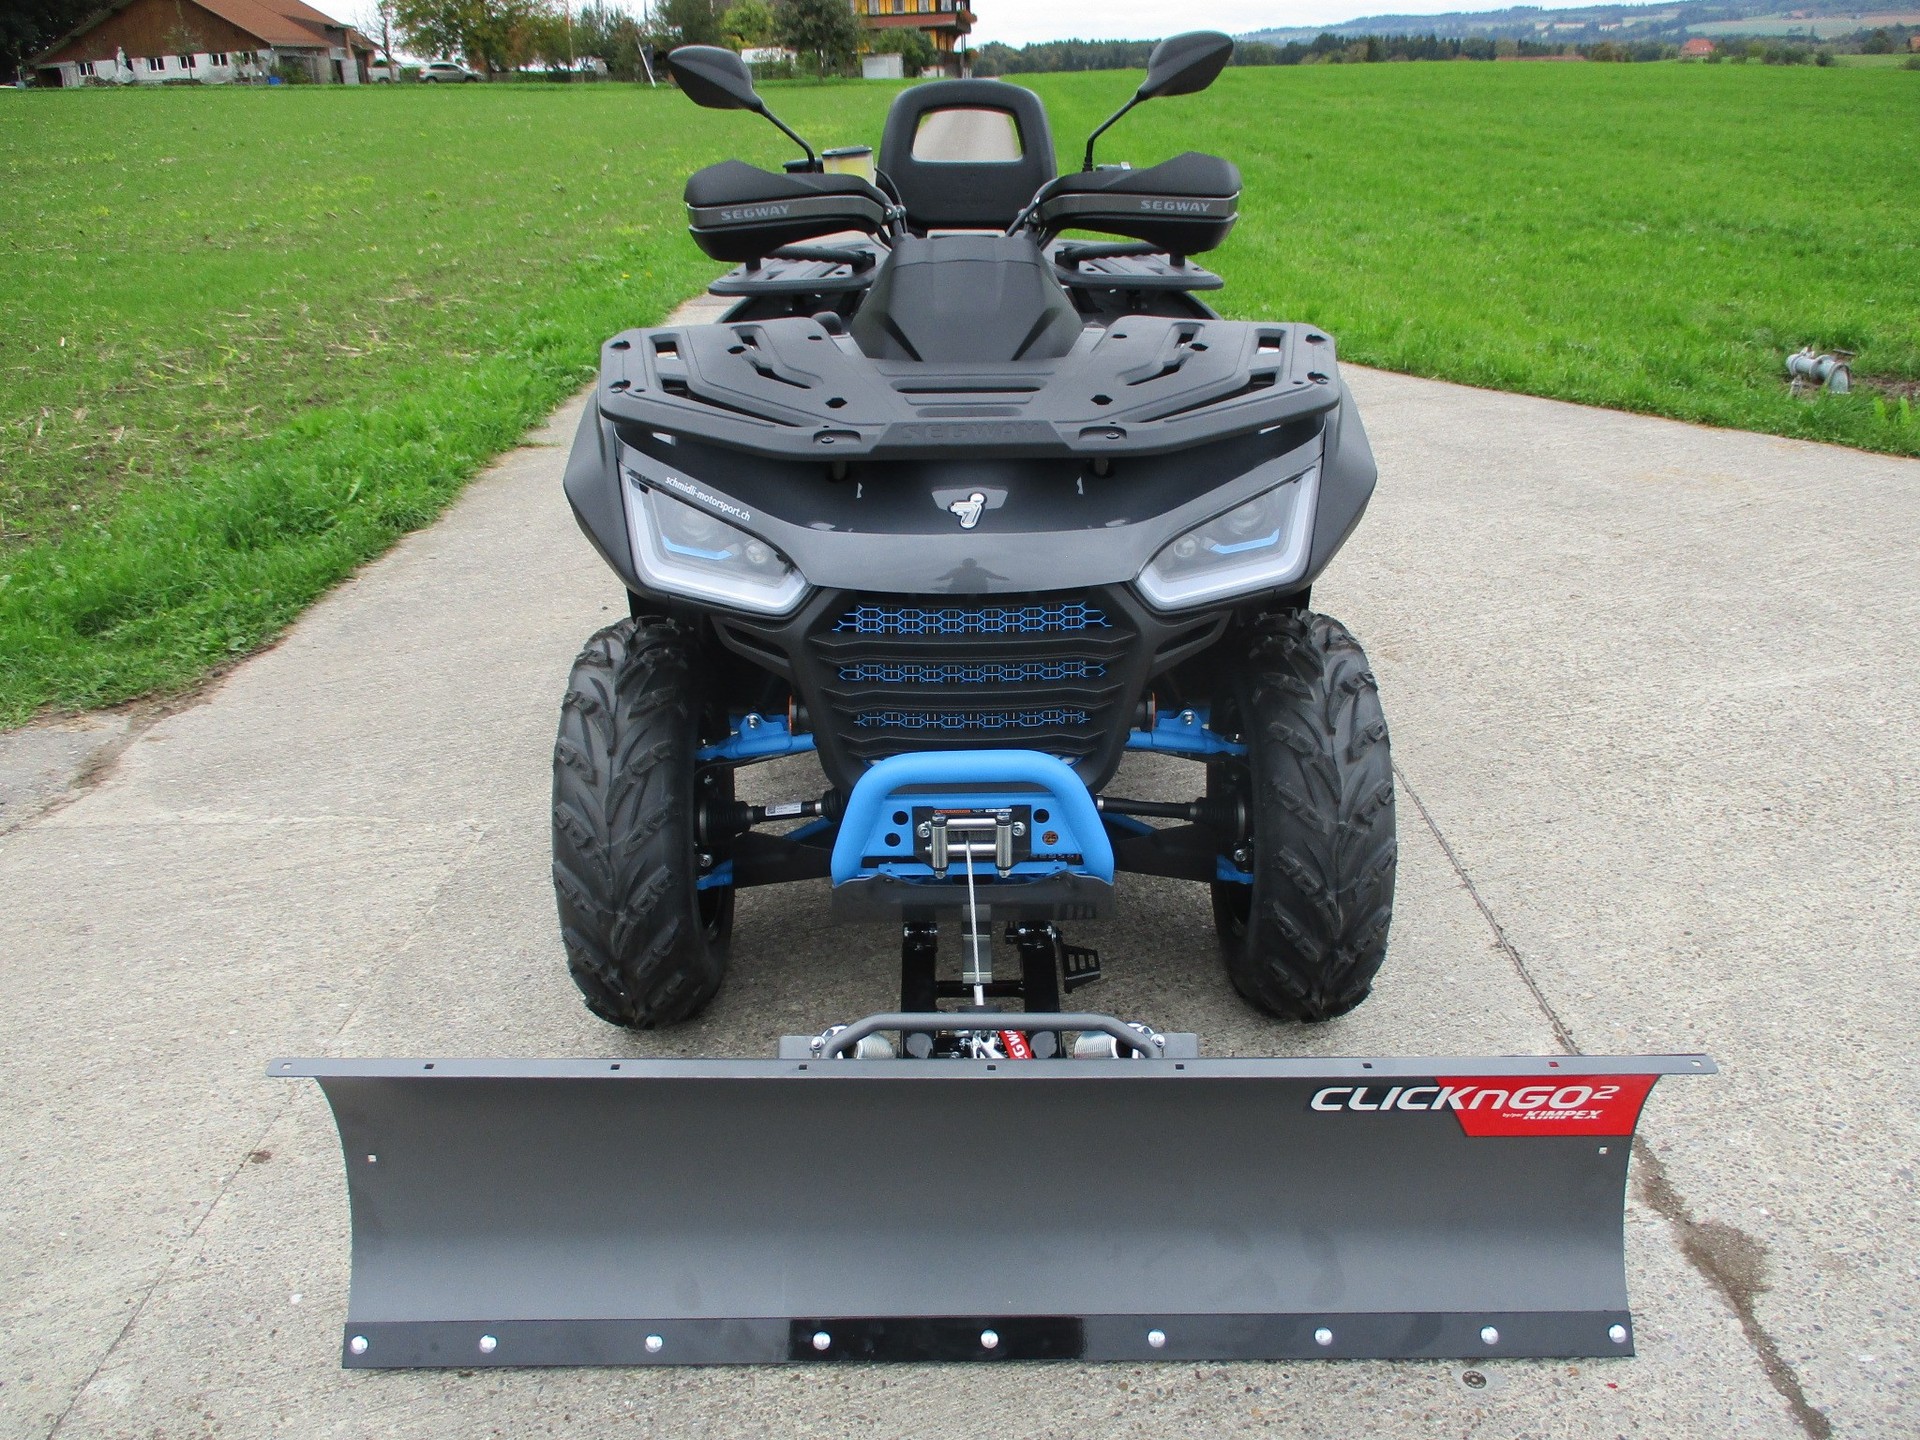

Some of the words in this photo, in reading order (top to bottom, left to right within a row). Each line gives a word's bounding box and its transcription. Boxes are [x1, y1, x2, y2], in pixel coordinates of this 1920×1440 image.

[720, 204, 789, 221] SEGWAY
[1140, 200, 1210, 212] SEGWAY
[901, 422, 1041, 439] SEGWAY
[665, 476, 751, 521] schmidli-motorsport.ch
[1523, 1110, 1604, 1120] KIMPEX
